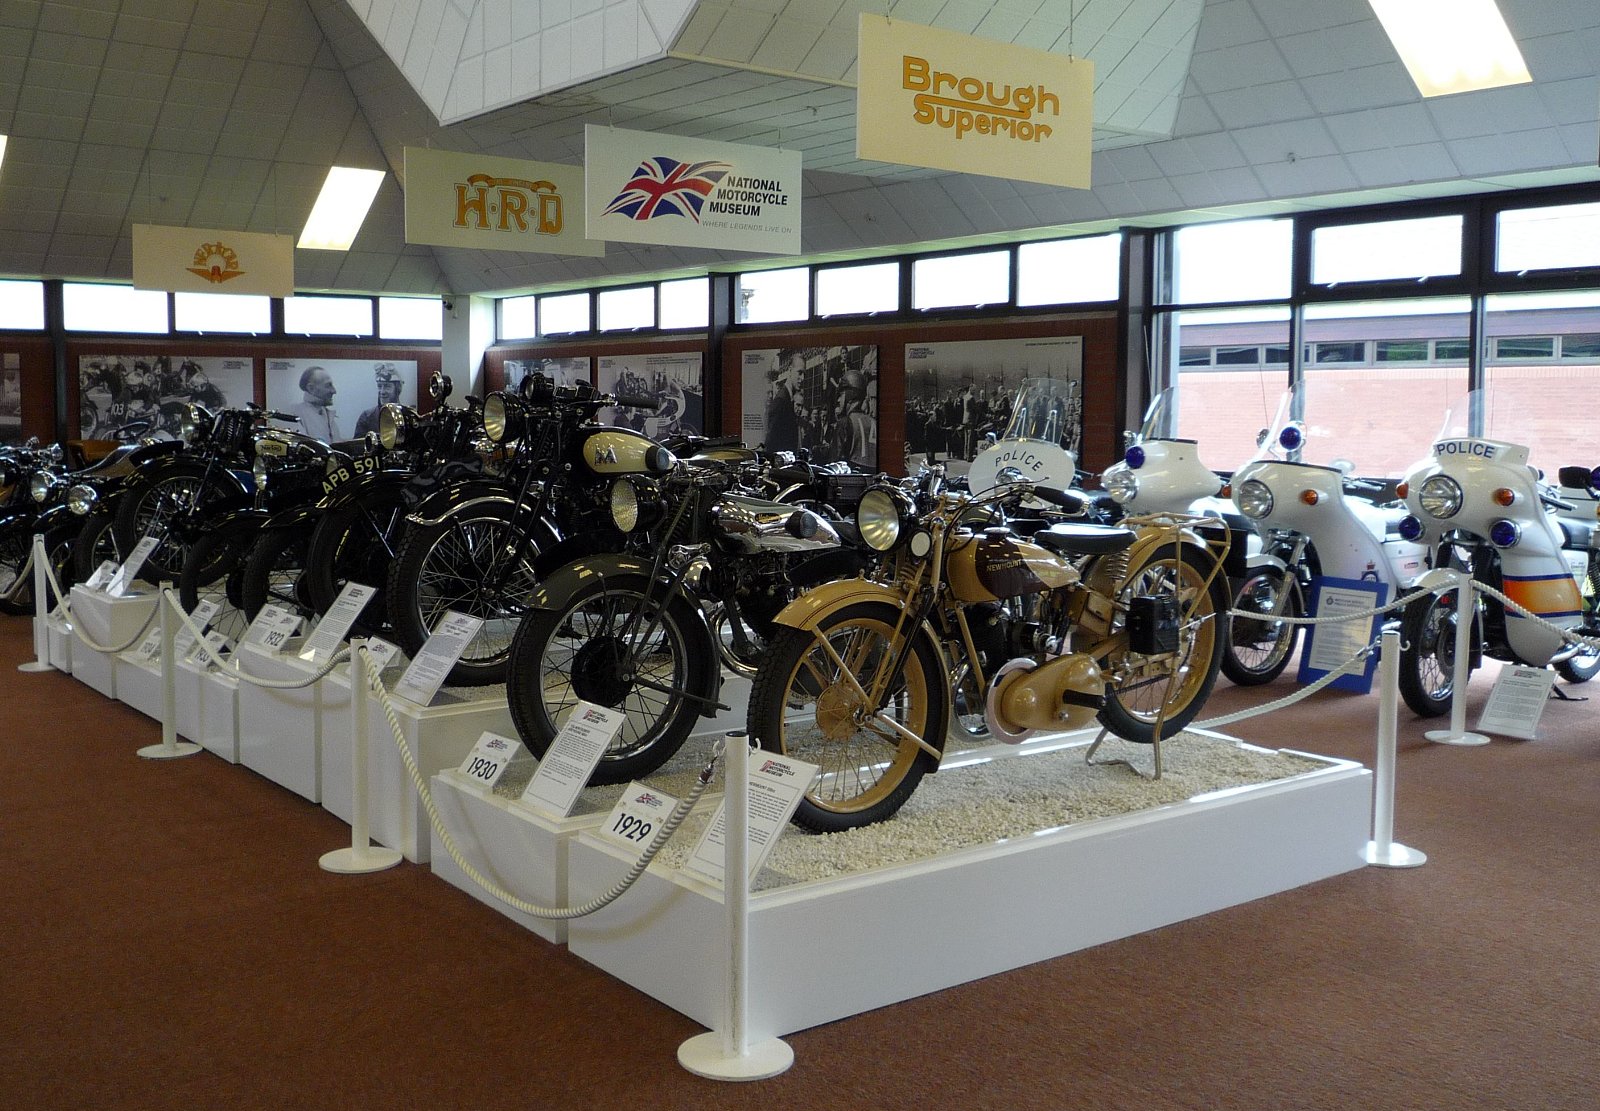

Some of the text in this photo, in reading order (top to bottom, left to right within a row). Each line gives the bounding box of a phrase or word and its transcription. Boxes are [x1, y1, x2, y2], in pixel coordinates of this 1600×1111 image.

[902, 55, 1060, 116] Brough
[913, 94, 1053, 143] Superior
[727, 175, 783, 192] NATIONAL
[716, 188, 788, 206] MOTORCYCLE
[708, 201, 761, 217] MUSEUM
[702, 220, 792, 234] WHERE LEGENDS LIVE ON
[1436, 441, 1496, 459] POLICE
[995, 449, 1044, 472] POLICE
[322, 455, 380, 495] APB 591
[263, 630, 286, 647] 1932
[466, 756, 498, 780] 1930
[612, 812, 652, 843] 1929
